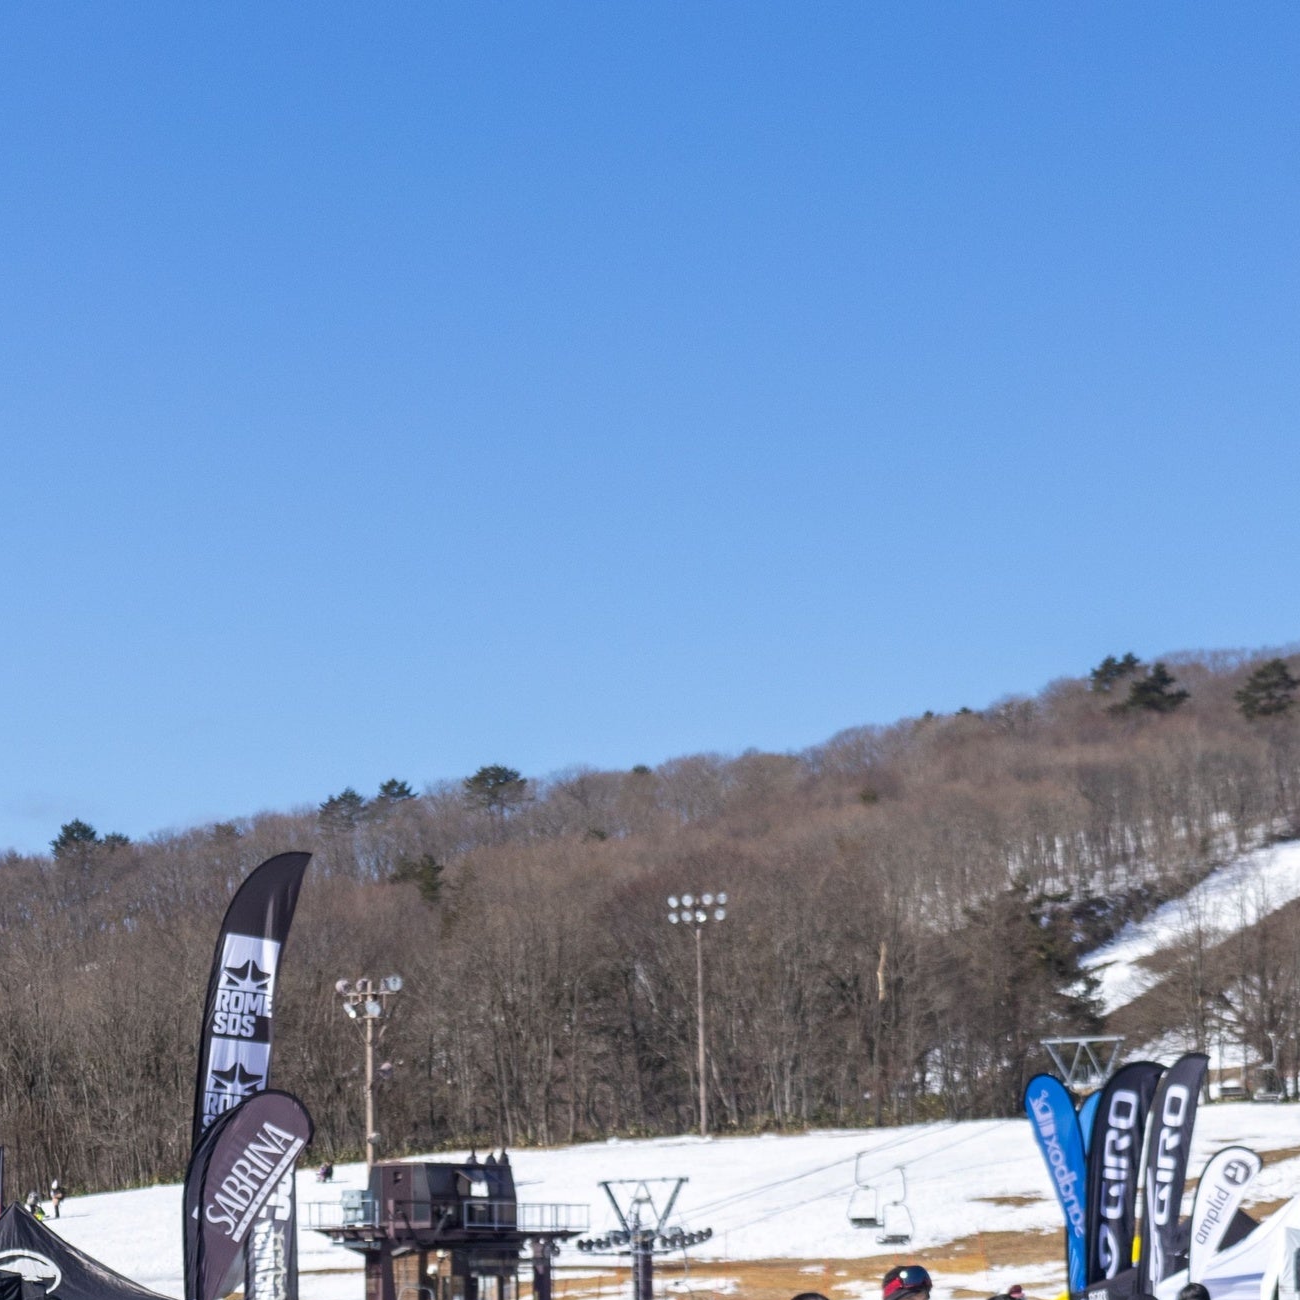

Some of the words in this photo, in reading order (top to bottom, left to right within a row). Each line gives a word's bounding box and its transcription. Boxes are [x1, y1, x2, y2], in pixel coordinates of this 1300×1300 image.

[212, 1012, 257, 1038] SDS
[215, 988, 274, 1018] ROME
[205, 1121, 296, 1236] SABRINA
[1100, 1089, 1139, 1220] GIRO
[1154, 1084, 1190, 1226] GIRO
[1194, 1185, 1231, 1246] amplid
